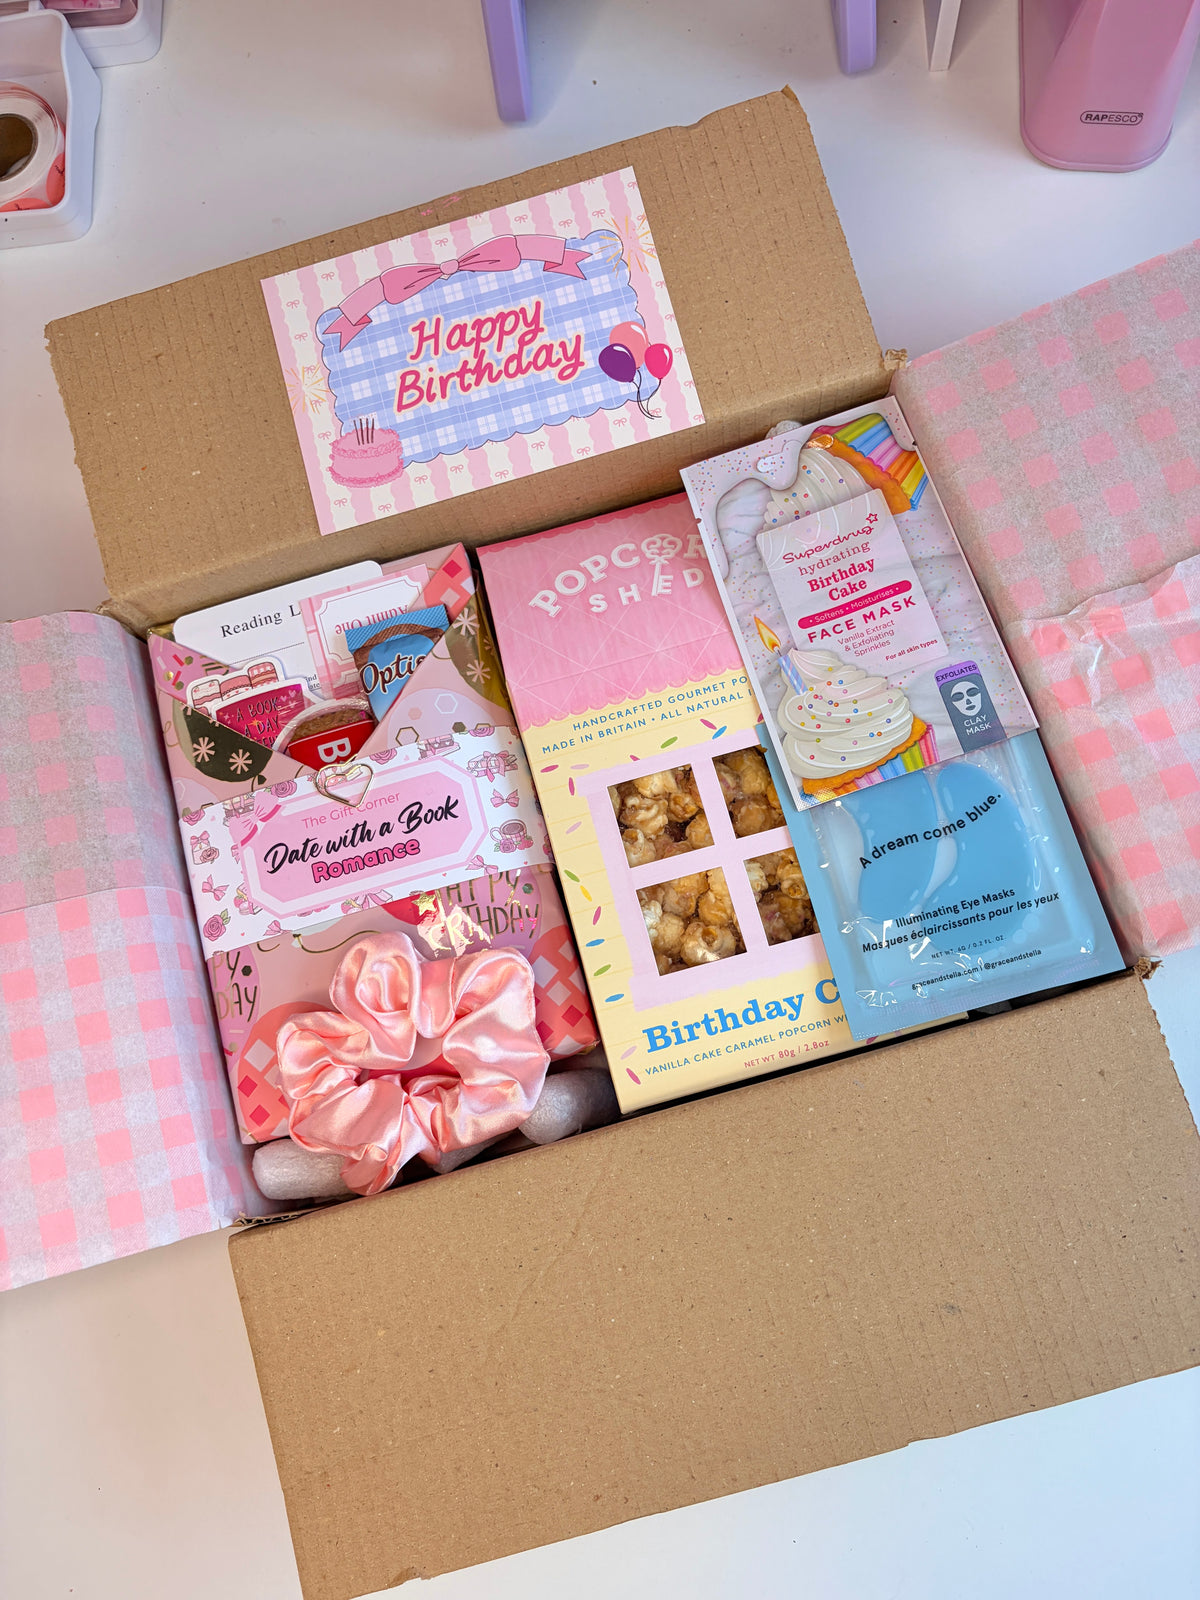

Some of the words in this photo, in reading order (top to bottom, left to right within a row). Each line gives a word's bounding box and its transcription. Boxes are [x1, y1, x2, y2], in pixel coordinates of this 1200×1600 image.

[1084, 113, 1138, 124] RAPESCO
[409, 300, 545, 361] Happy
[396, 334, 585, 413] Birthday
[782, 525, 874, 565] Superdrug
[798, 541, 871, 577] hydrating
[807, 558, 875, 593] Birthday
[828, 580, 868, 602] Cake
[807, 618, 857, 644] FACE
[862, 595, 916, 624] MASK
[814, 607, 845, 623] Softens
[851, 589, 894, 609] Moisturises
[220, 612, 283, 638] Reading
[837, 631, 865, 645] Vanilla
[866, 619, 895, 635] Extract
[844, 644, 852, 652] &
[852, 629, 895, 649] Exfoliating
[854, 639, 891, 657] Sprinkles
[885, 653, 897, 661] For
[897, 649, 906, 657] all
[906, 644, 920, 654] skin
[920, 639, 938, 650] types
[935, 664, 978, 682] EXFOLIATES
[236, 708, 244, 722] A
[248, 697, 279, 718] BOOK
[573, 700, 663, 731] HANDCRAFTED
[668, 681, 726, 704] GOURMET
[963, 714, 987, 727] CLAY
[257, 716, 280, 734] DAY
[542, 738, 576, 755] MADE
[580, 732, 593, 745] IN
[598, 718, 647, 739] BRITAIN
[660, 708, 682, 721] ALL
[687, 692, 744, 713] NATURAL
[966, 722, 992, 736] MASK
[264, 837, 323, 874] Date
[326, 820, 376, 854] with
[379, 821, 395, 837] a
[397, 795, 459, 834] Book
[302, 816, 327, 829] The
[330, 807, 354, 821] Gift
[859, 856, 872, 869] A
[871, 832, 919, 860] dream
[923, 819, 966, 841] come
[965, 793, 1002, 823] blue.
[311, 839, 421, 883] Romance
[862, 931, 909, 953] Masques
[910, 912, 986, 939] éclaircissants
[988, 904, 1014, 921] pour
[1016, 898, 1033, 911] les
[1034, 892, 1060, 908] yeux
[895, 902, 960, 928] Illuminating
[960, 898, 981, 914] Eye
[982, 888, 1016, 904] Masks
[984, 949, 1042, 971] @graceandstella
[642, 992, 805, 1053] Birthday
[645, 1058, 691, 1075] VANILLA
[694, 1049, 722, 1063] CAKE
[725, 1034, 776, 1054] CARAMEL
[779, 1018, 831, 1039] POPCORN
[744, 1058, 761, 1068] NET
[761, 1054, 775, 1064] WT
[778, 1048, 796, 1059] 80g
[805, 1040, 830, 1052] 2.8oz
